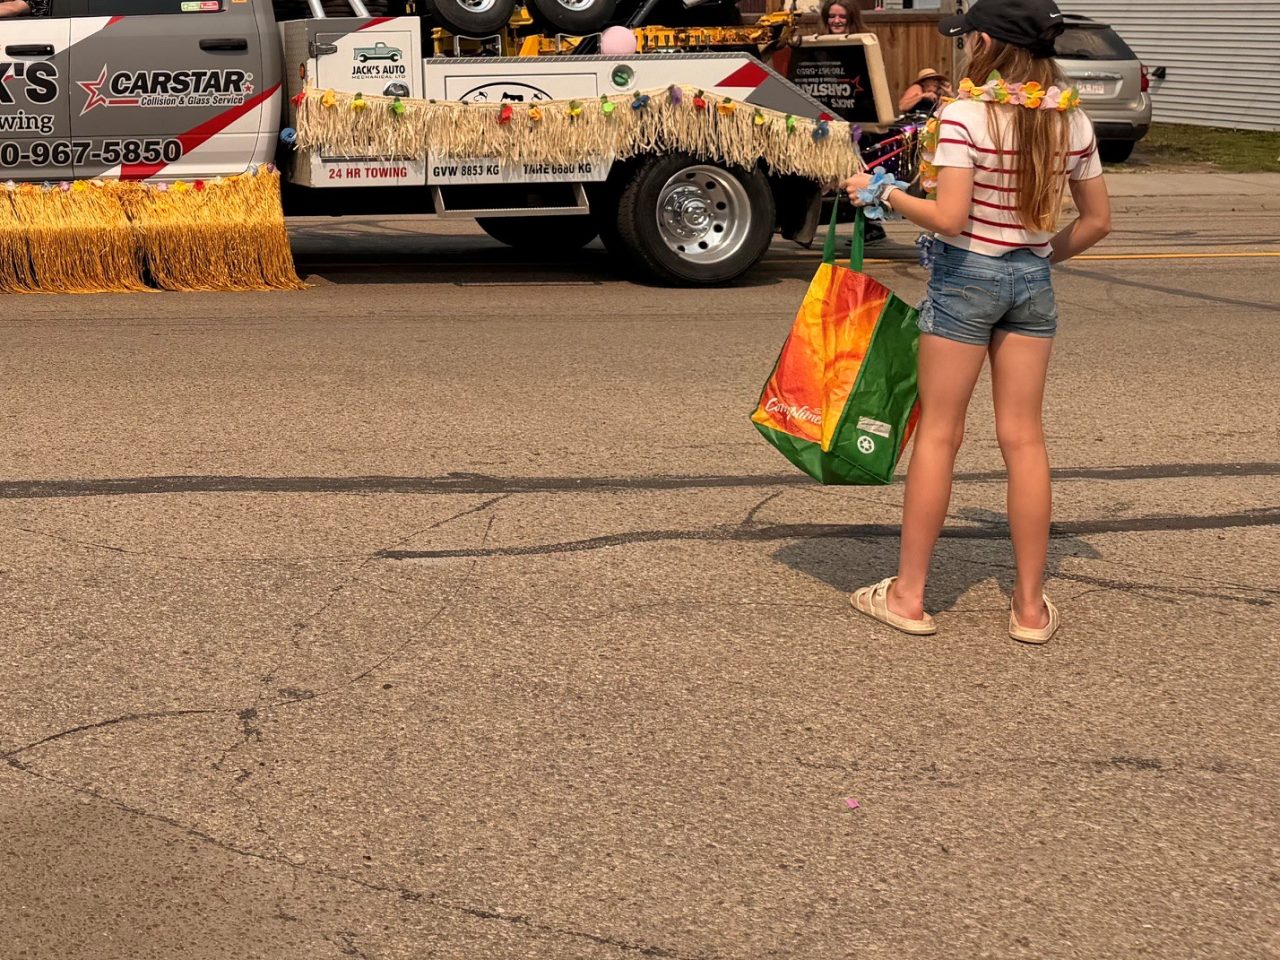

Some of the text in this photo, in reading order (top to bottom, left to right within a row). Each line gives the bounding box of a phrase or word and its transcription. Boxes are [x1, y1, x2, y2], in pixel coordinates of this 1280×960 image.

[351, 64, 406, 75] JACK'S AUTO
[110, 70, 246, 95] CARSTAR
[140, 94, 244, 106] Collision & Glass Service
[328, 166, 408, 179] 24 HR TOWING
[433, 164, 500, 177] GVW 8853 KG
[523, 163, 550, 175] TARE
[578, 162, 592, 174] KG
